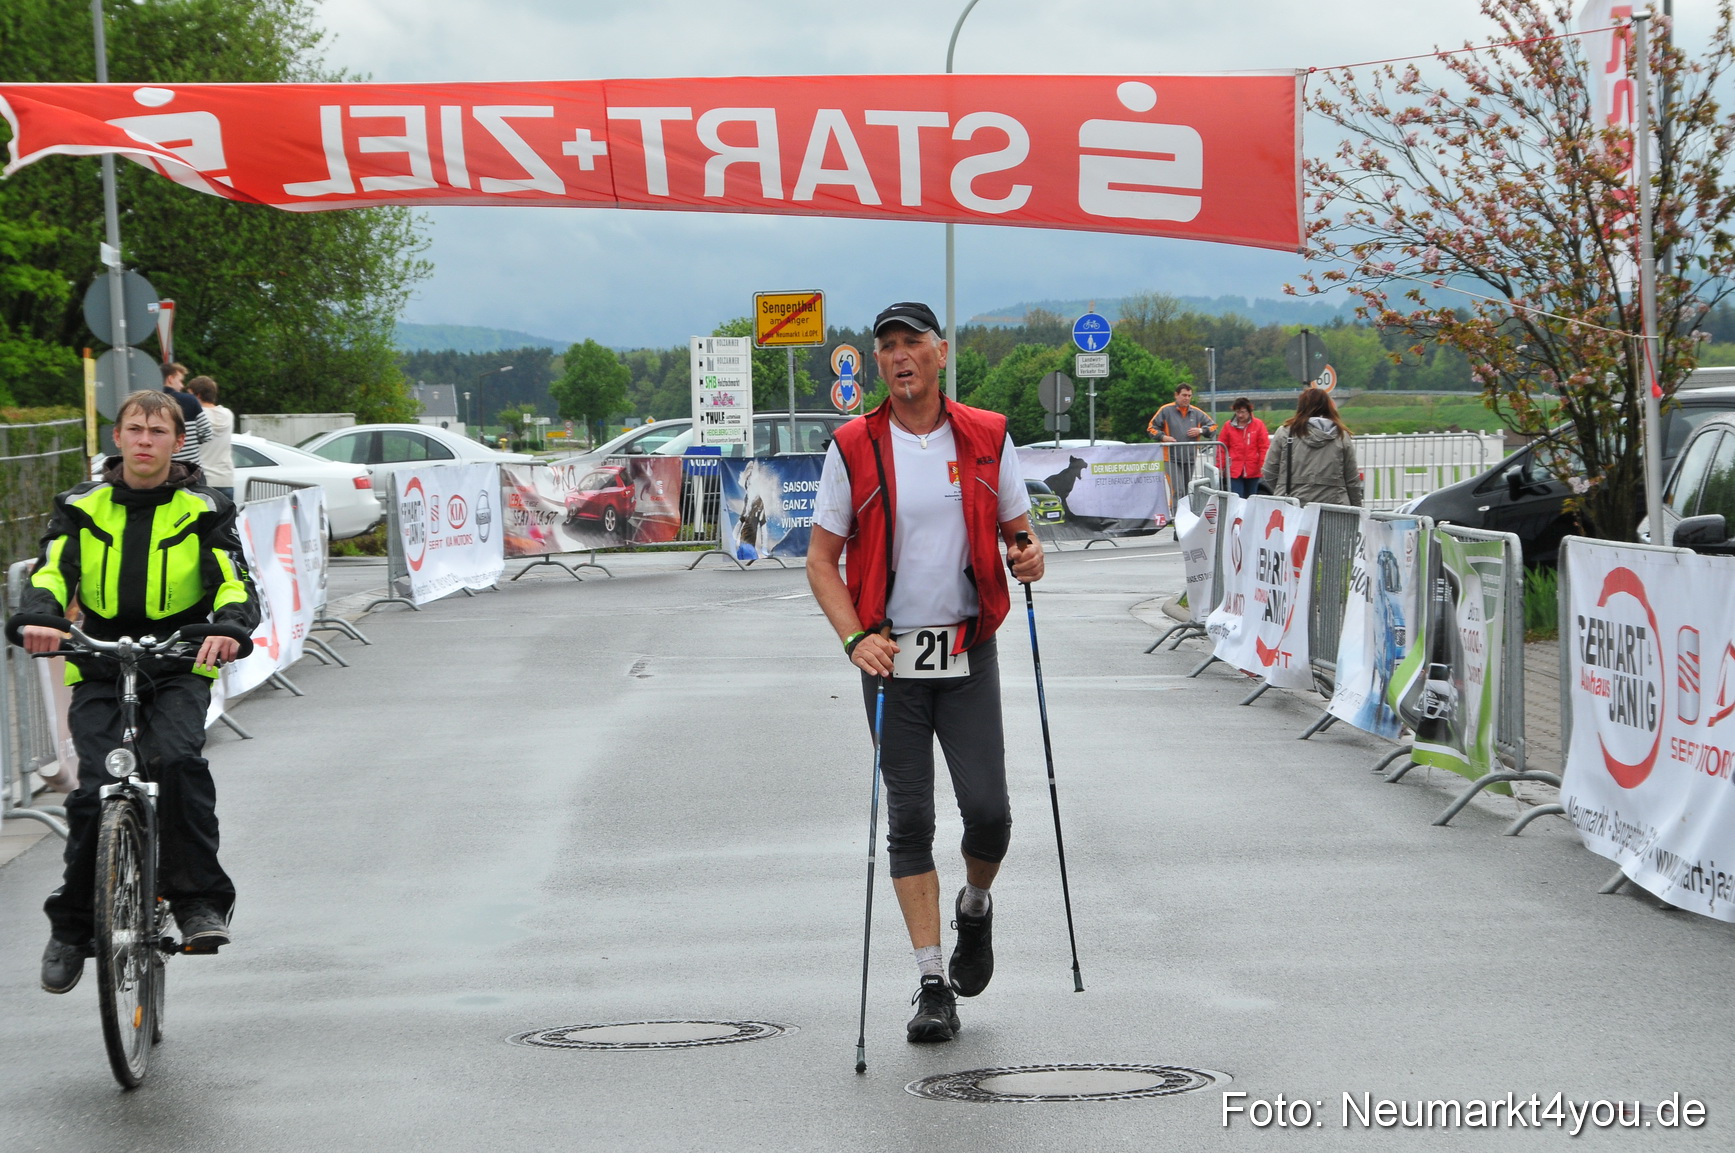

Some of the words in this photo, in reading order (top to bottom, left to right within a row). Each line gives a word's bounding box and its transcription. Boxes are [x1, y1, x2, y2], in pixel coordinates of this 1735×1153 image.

[762, 301, 817, 316] Sengenthal
[785, 317, 810, 326] Anger
[705, 375, 718, 389] SHB
[706, 411, 725, 425] THULE
[1093, 465, 1105, 473] DER
[1105, 464, 1118, 472] NEUE
[1118, 463, 1140, 472] PICANTO
[1140, 463, 1148, 471] IST
[449, 503, 464, 521] KIA
[782, 499, 808, 511] GANZ
[914, 630, 949, 671] 21
[1608, 673, 1657, 733] JÄNIG
[1568, 795, 1609, 838] Neumarkt
